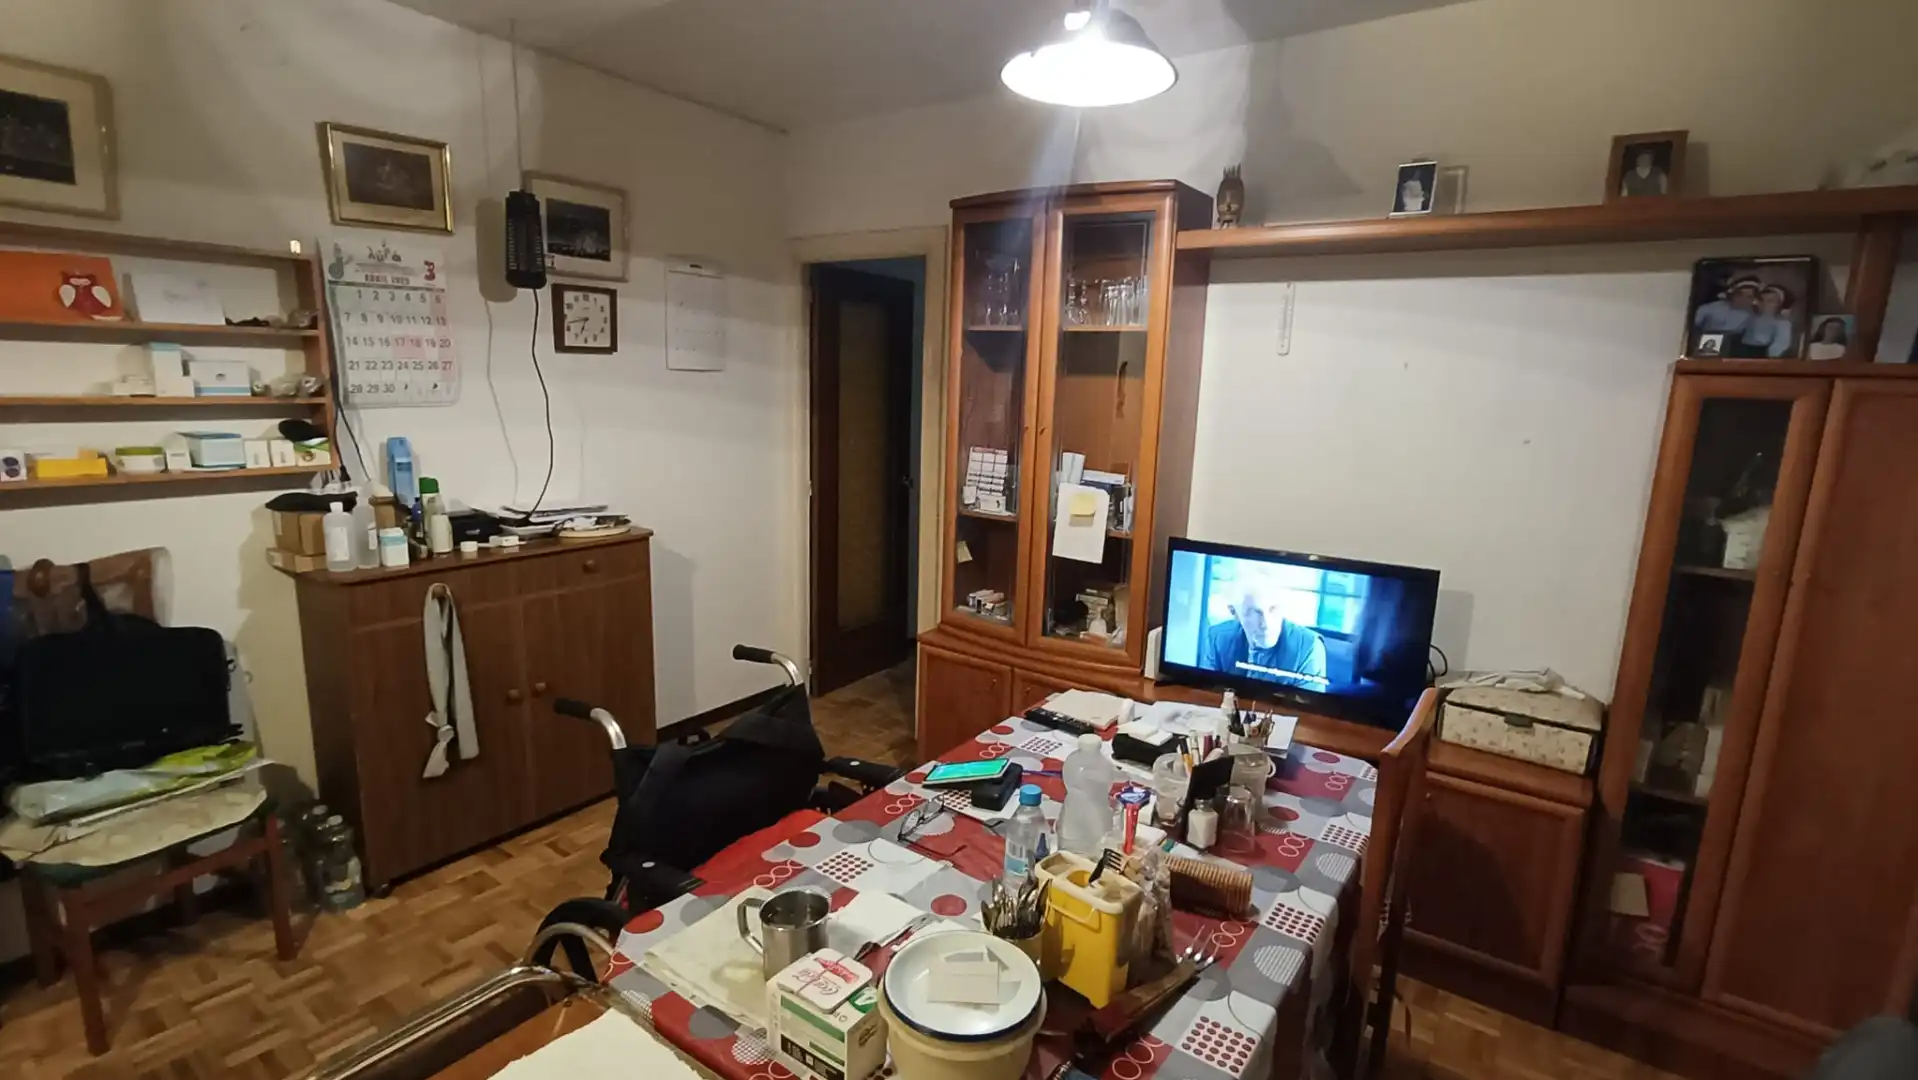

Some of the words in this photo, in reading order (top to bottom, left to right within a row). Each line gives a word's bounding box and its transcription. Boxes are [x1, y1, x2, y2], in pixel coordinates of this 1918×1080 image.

[357, 289, 362, 299] 1
[373, 290, 380, 300] 2
[344, 312, 351, 321] 7
[406, 316, 417, 324] 11
[421, 316, 431, 325] 12
[440, 339, 451, 348] 20
[348, 360, 360, 370] 21
[365, 361, 378, 370] 22
[381, 361, 394, 370] 23
[398, 361, 409, 370] 24
[412, 361, 424, 370] 25
[441, 361, 453, 370] 27
[366, 384, 379, 393] 29
[383, 384, 396, 393] 30
